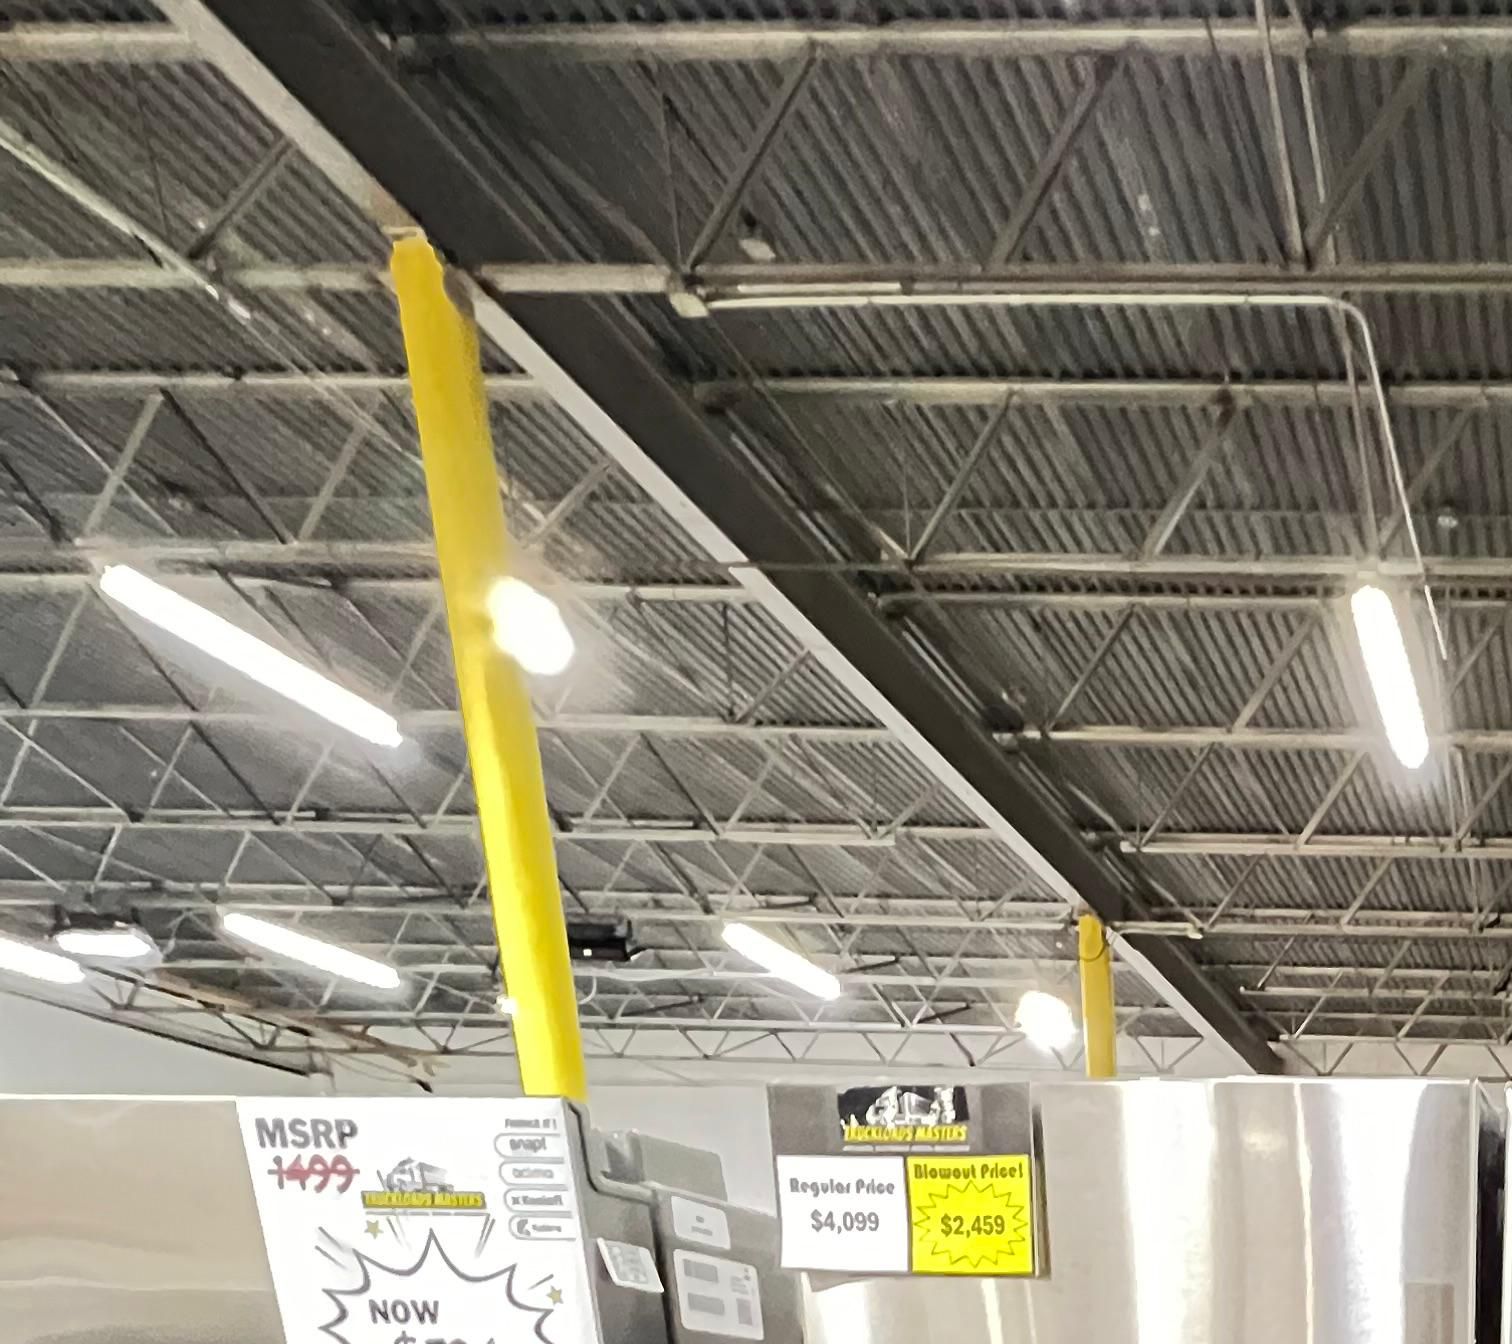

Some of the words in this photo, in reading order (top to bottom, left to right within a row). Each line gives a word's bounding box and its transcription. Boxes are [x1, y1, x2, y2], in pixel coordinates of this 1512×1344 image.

[255, 1117, 358, 1149] MSRP
[269, 1154, 358, 1194] 1499
[914, 1163, 976, 1180] Blowout
[981, 1163, 1024, 1180] Price!
[789, 1177, 851, 1198] Regular
[855, 1179, 895, 1195] Price
[810, 1209, 880, 1234] $4,099
[941, 1214, 1006, 1237] $2,459
[368, 1299, 439, 1324] NOW
